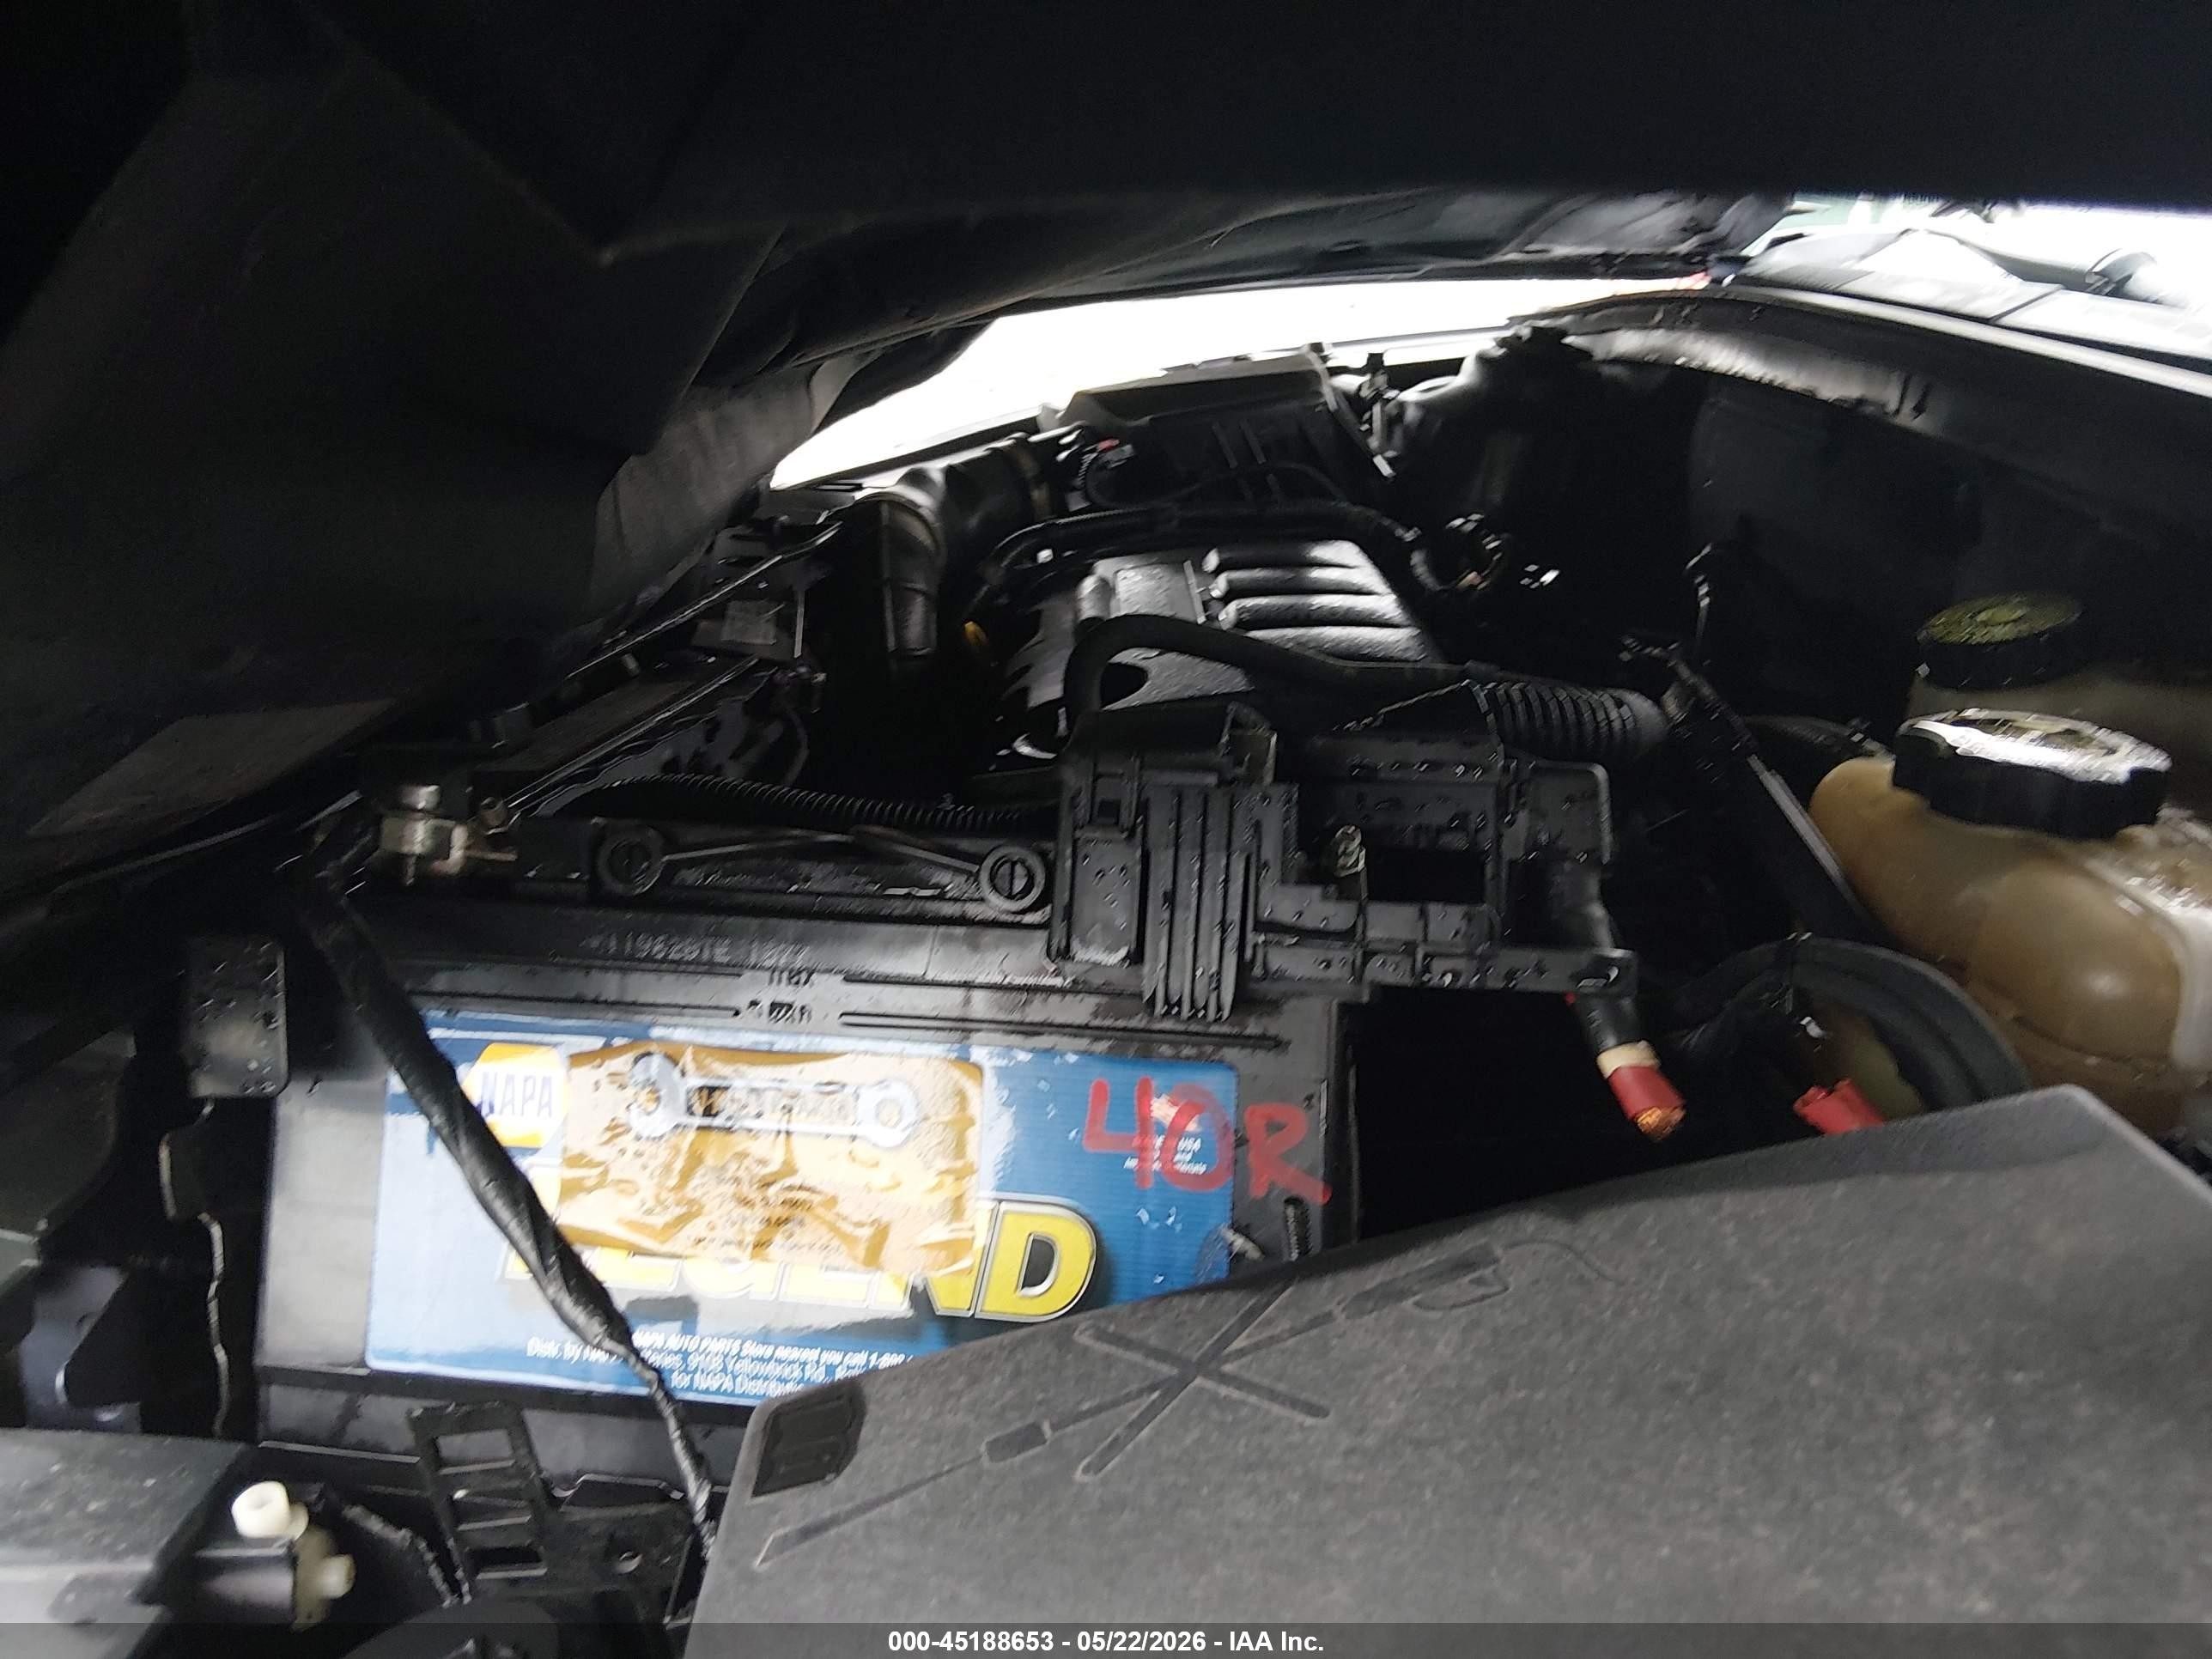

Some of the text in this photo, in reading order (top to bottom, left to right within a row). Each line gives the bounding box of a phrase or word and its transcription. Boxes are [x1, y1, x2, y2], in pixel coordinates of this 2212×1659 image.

[477, 1071, 553, 1118] NAPA
[562, 1340, 583, 1364] by
[665, 1332, 700, 1353] AUTO
[700, 1335, 741, 1358] PARTS
[820, 1349, 845, 1368] you
[843, 1349, 869, 1369] call
[692, 1371, 735, 1395] NAPA
